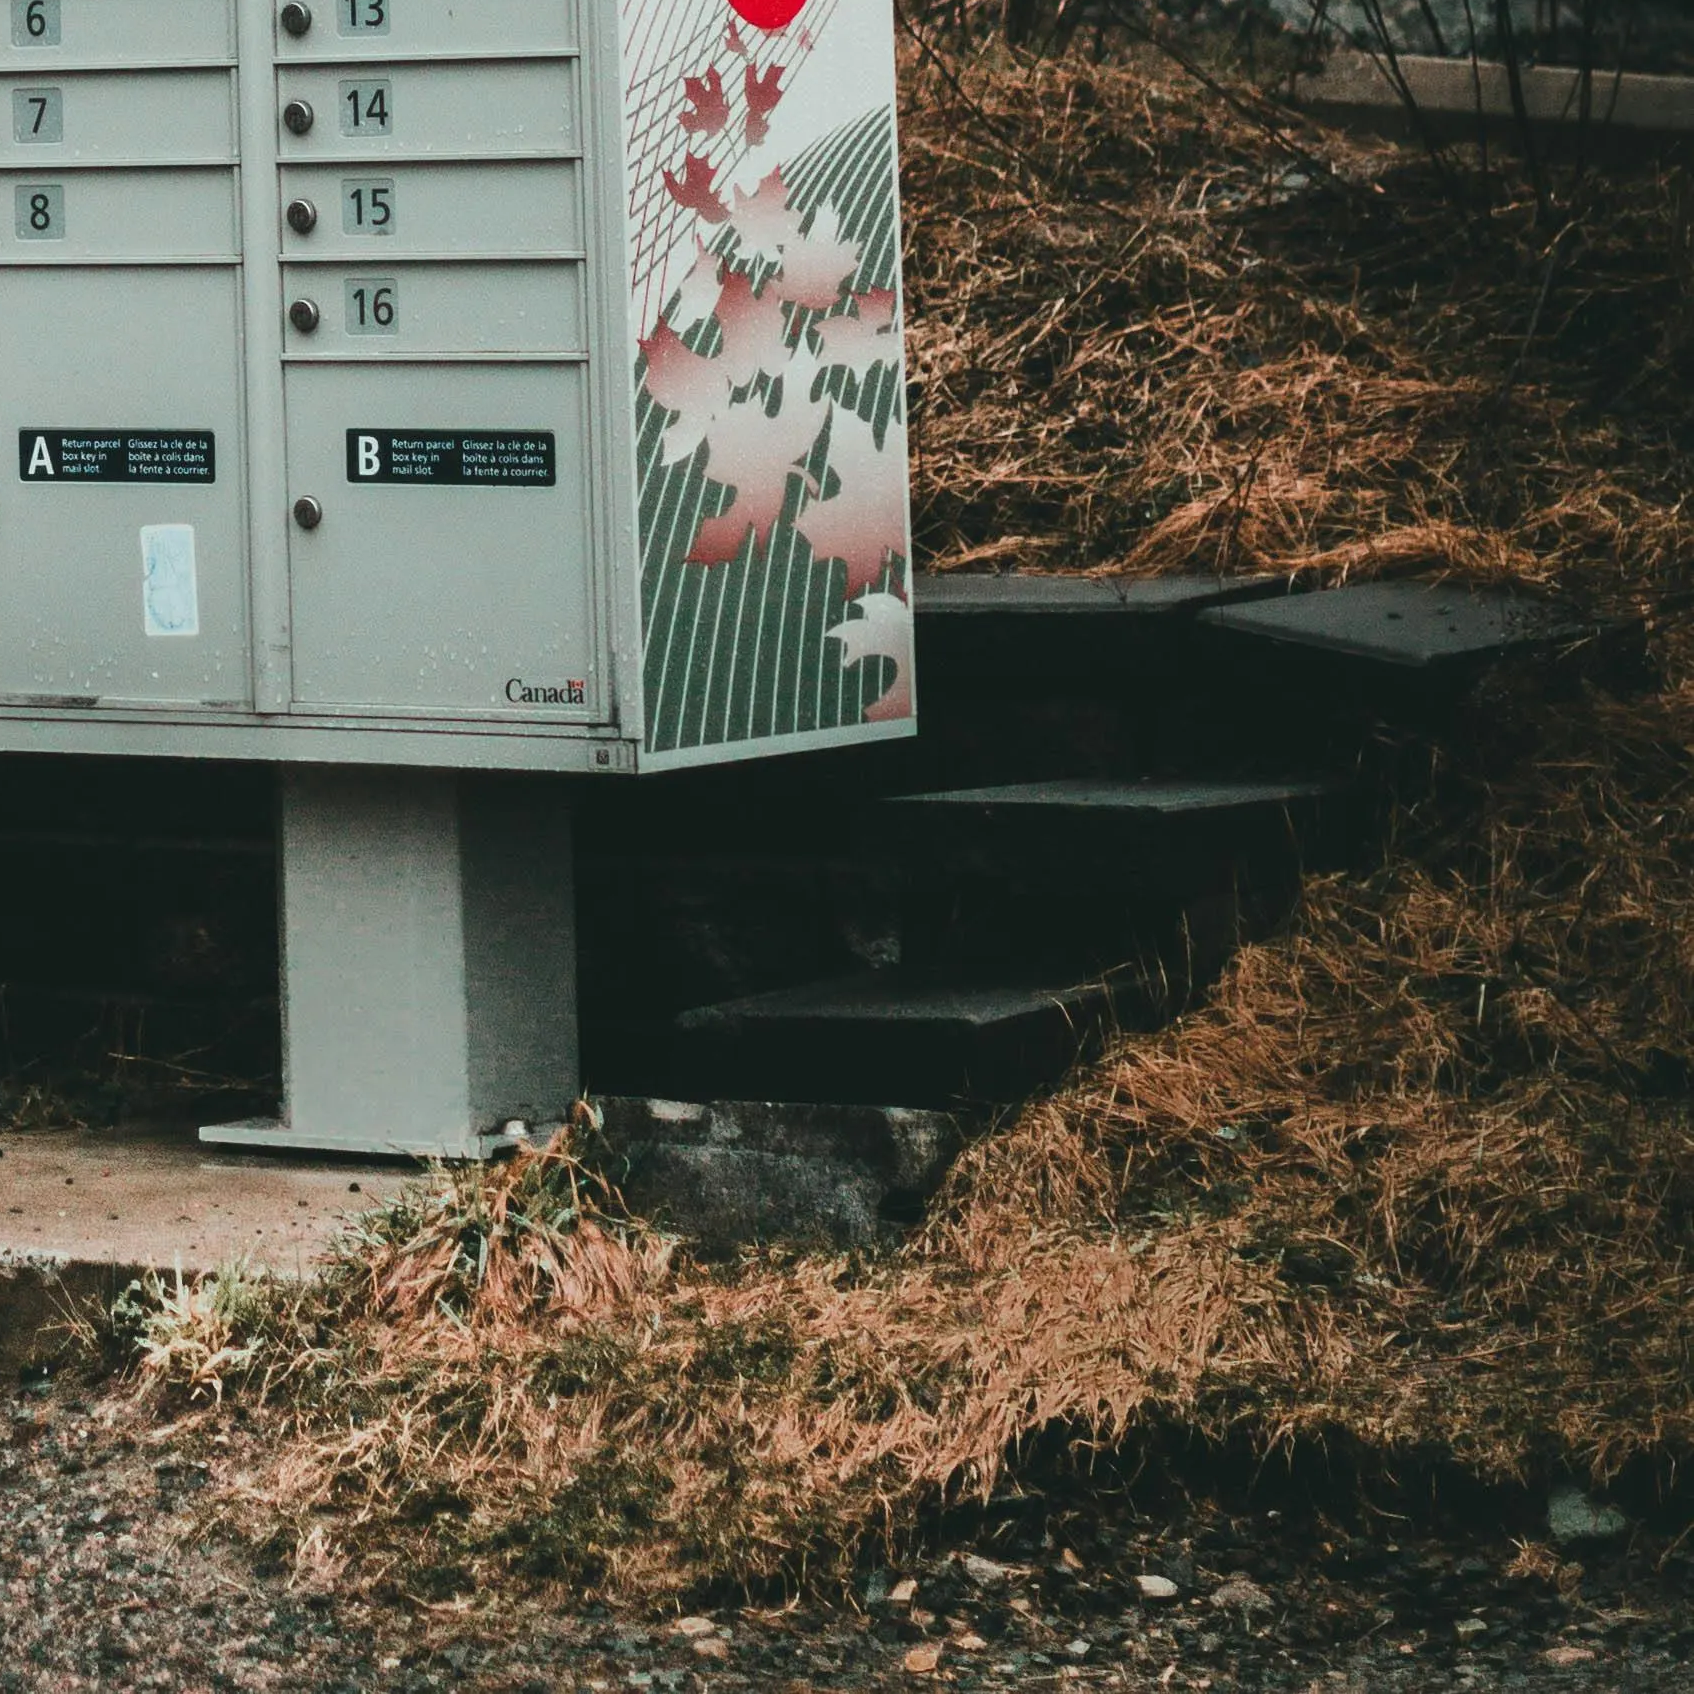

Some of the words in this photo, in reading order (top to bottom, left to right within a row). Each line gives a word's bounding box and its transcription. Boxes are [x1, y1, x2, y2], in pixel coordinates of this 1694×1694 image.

[26, 0, 46, 37] 6
[346, 88, 389, 127] 14
[28, 97, 47, 134] 7
[30, 193, 51, 231] 8
[350, 187, 391, 226] 15
[352, 287, 394, 326] 16
[62, 439, 91, 448] Return
[94, 439, 120, 451] parcel
[128, 439, 157, 449] Glissez
[392, 439, 424, 449] Return
[426, 440, 454, 452] parcel
[462, 440, 493, 450] Glissez
[28, 435, 55, 475] A
[62, 452, 78, 460] box
[81, 452, 96, 462] key
[161, 452, 180, 461] colis
[183, 452, 205, 462] dans
[358, 435, 381, 476] B
[392, 452, 409, 461] box
[412, 452, 428, 463] key
[498, 453, 519, 463] colis
[521, 454, 544, 463] dans
[62, 464, 82, 472] mail
[83, 464, 102, 473] slot.
[139, 464, 162, 473] fente
[173, 466, 210, 475] courrier.
[392, 465, 412, 474] mail
[415, 466, 434, 475] slot.
[474, 466, 499, 476] fente
[510, 468, 548, 476] courrier.
[505, 678, 585, 705] Canada
